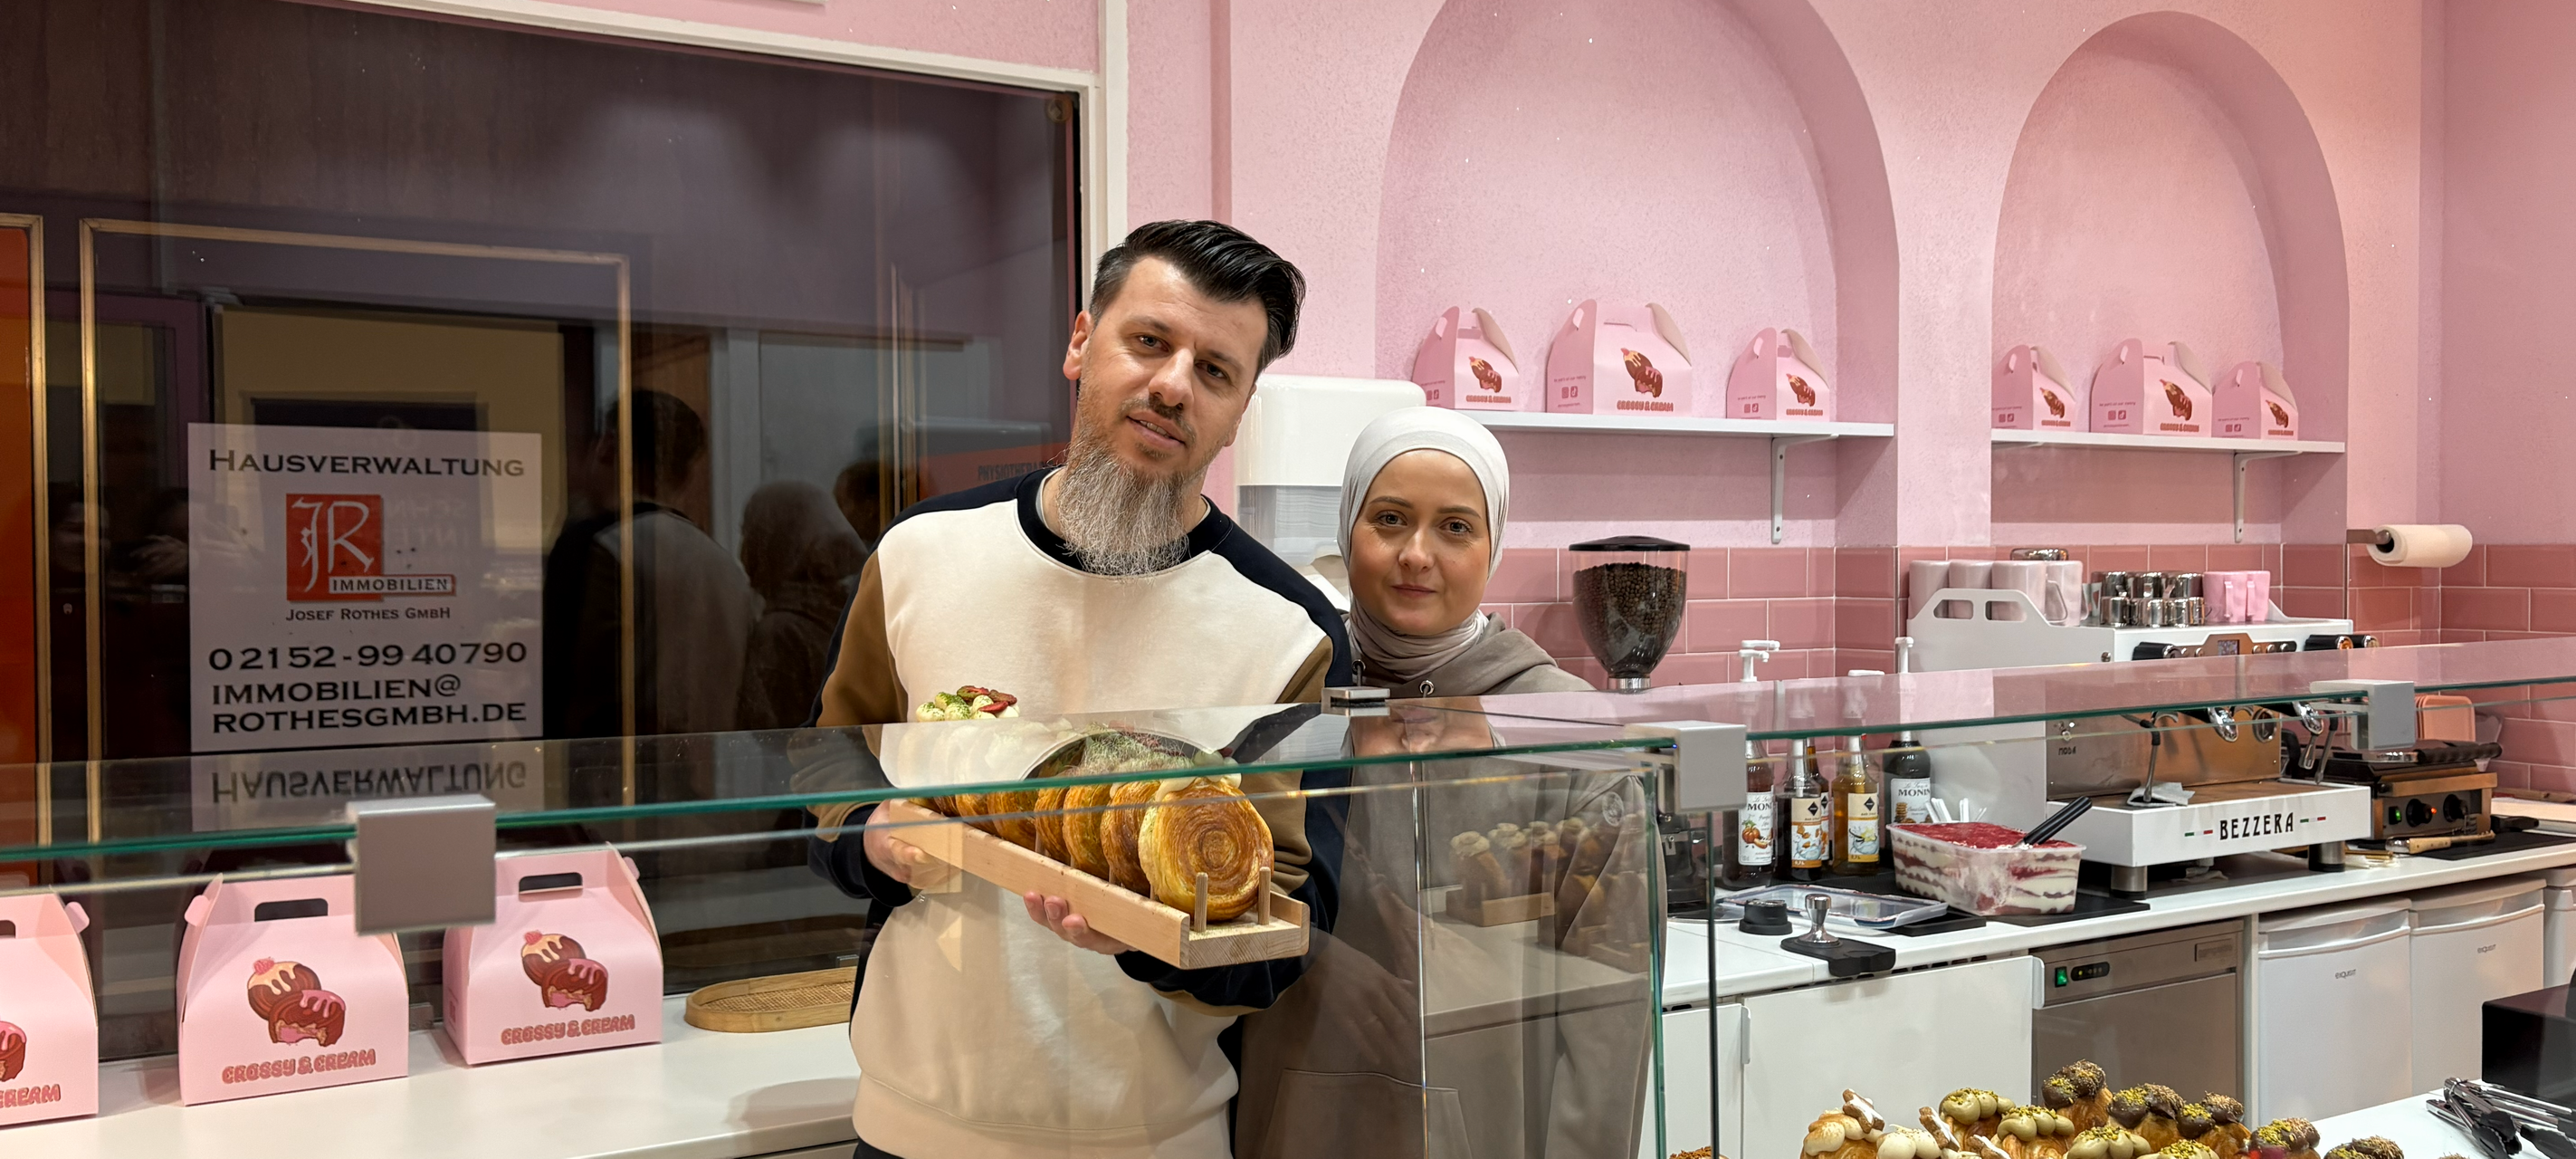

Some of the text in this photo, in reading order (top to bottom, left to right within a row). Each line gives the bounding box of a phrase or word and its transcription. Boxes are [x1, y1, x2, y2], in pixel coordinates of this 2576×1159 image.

[209, 449, 525, 476] HAUSVERWALTUNG
[332, 578, 449, 592] IMMOBILIEN
[286, 608, 335, 621] JOSEF
[340, 608, 399, 620] ROTHES
[213, 674, 462, 705] IMMOBILIEN@
[213, 702, 527, 733] ROTHESGMBH.DE
[2219, 812, 2294, 840] BEZZERA
[501, 1013, 635, 1046] CROSSY & CREAM
[222, 1049, 377, 1084] CROSSY & CREAM
